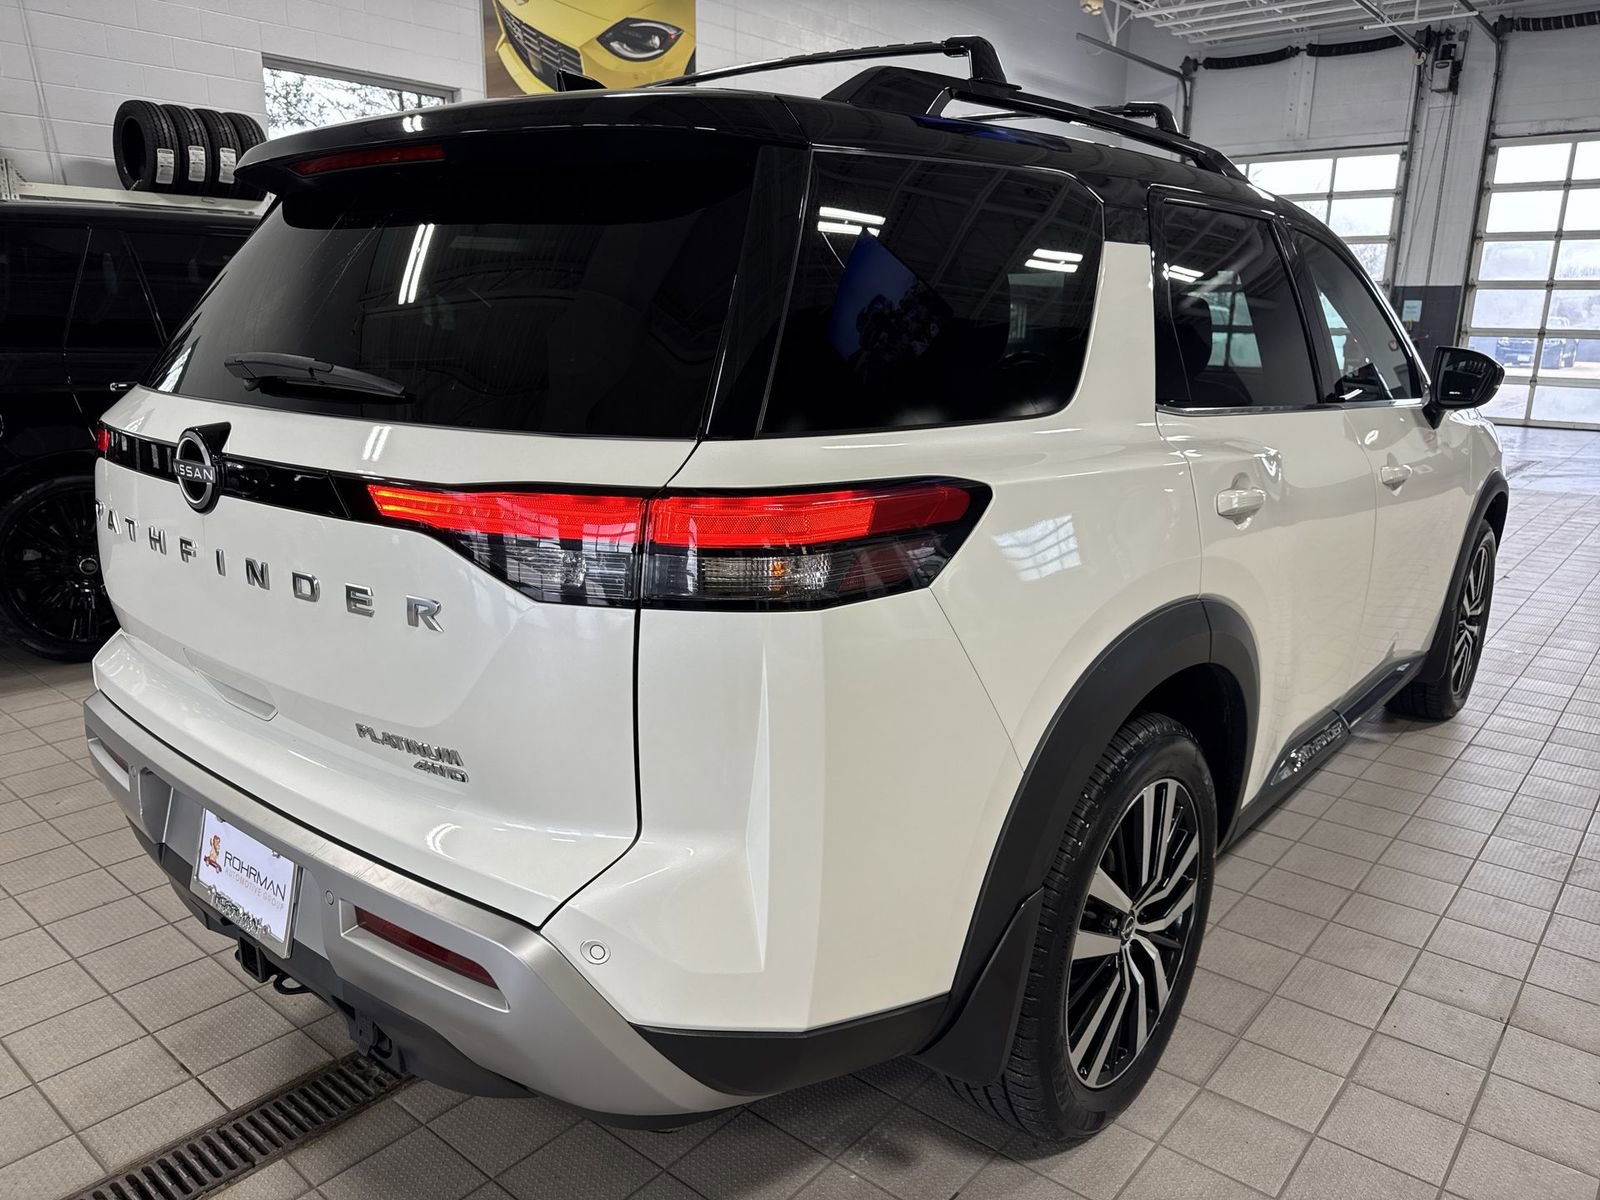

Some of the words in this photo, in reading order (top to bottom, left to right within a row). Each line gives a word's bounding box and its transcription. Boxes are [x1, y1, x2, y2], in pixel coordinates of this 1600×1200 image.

[95, 498, 445, 633] PATHFINDER
[355, 723, 465, 767] PLATINUM
[413, 759, 470, 783] 4WD
[224, 850, 287, 901] ROHRMAN
